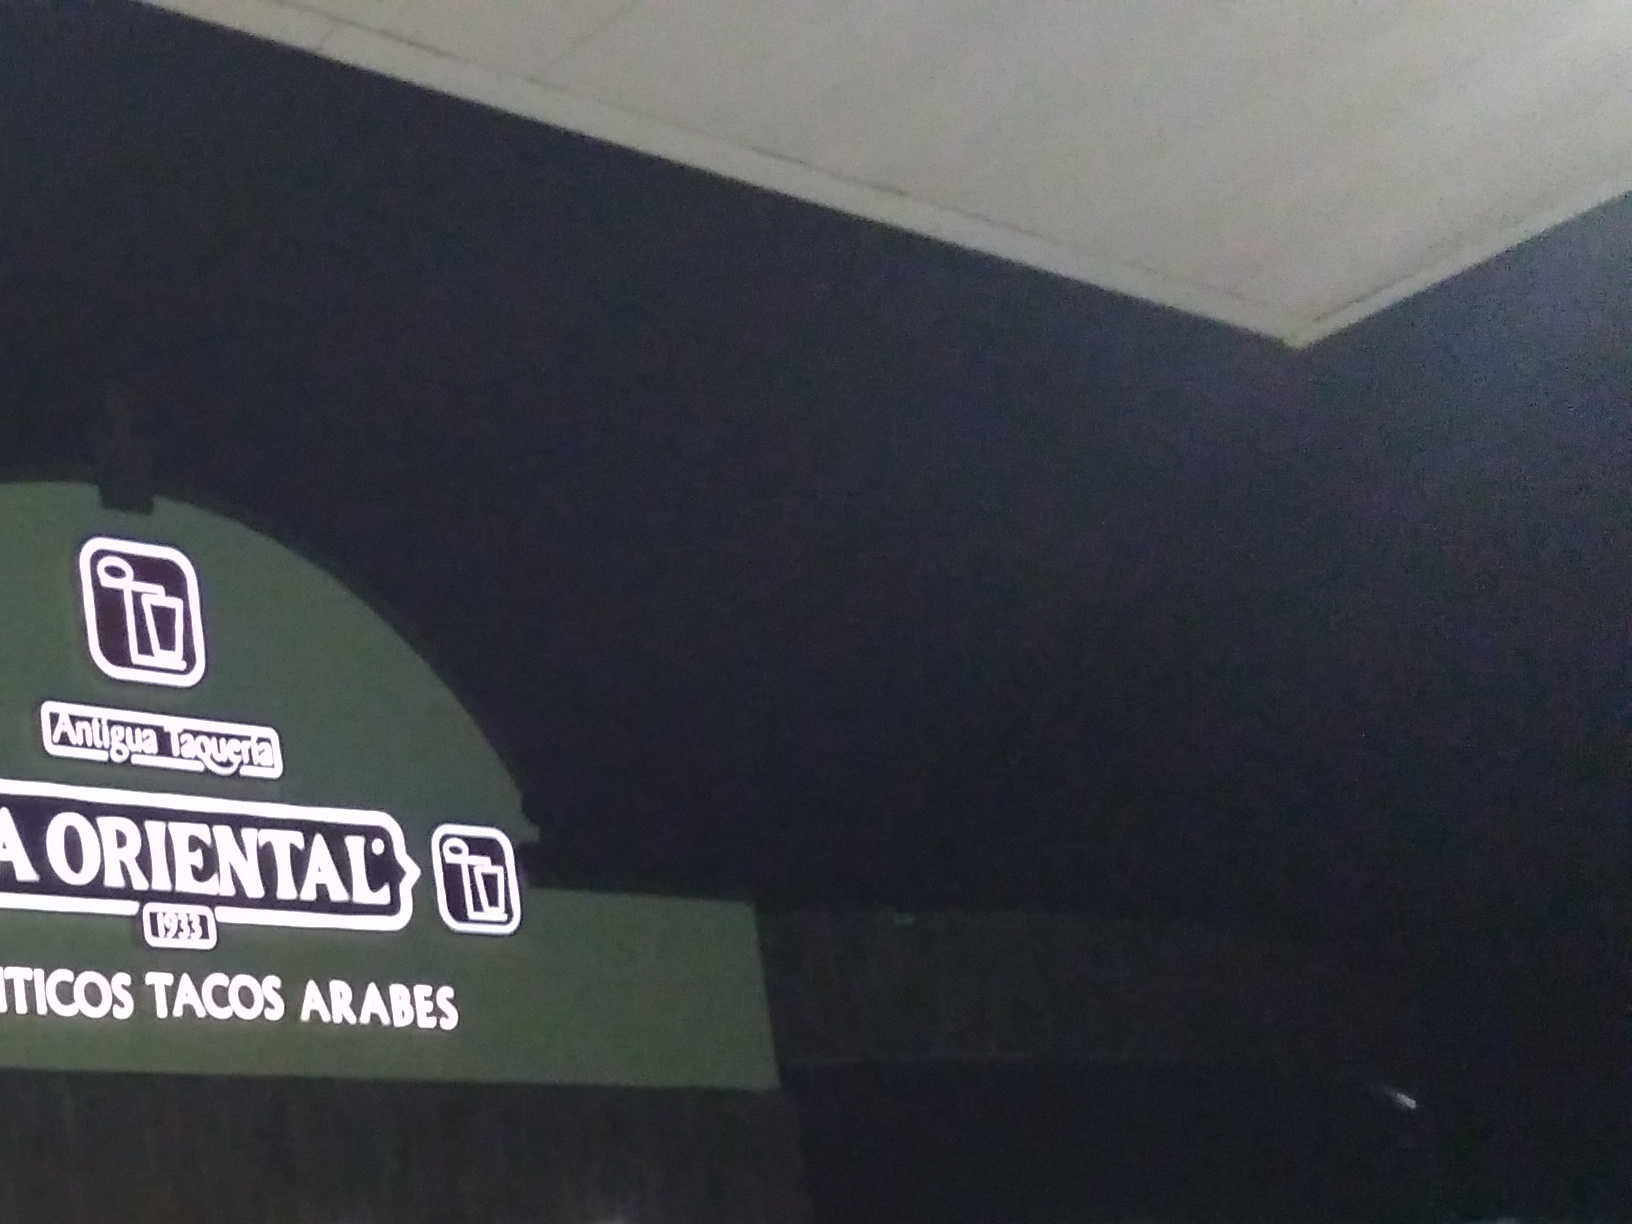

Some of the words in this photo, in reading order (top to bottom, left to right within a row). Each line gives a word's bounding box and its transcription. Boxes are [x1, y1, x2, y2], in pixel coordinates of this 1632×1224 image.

[52, 711, 158, 763] Antigua
[46, 812, 391, 904] ORIENTAL
[156, 911, 203, 939] 1933
[145, 972, 285, 1022] TACOS
[301, 980, 459, 1032] ARABES
